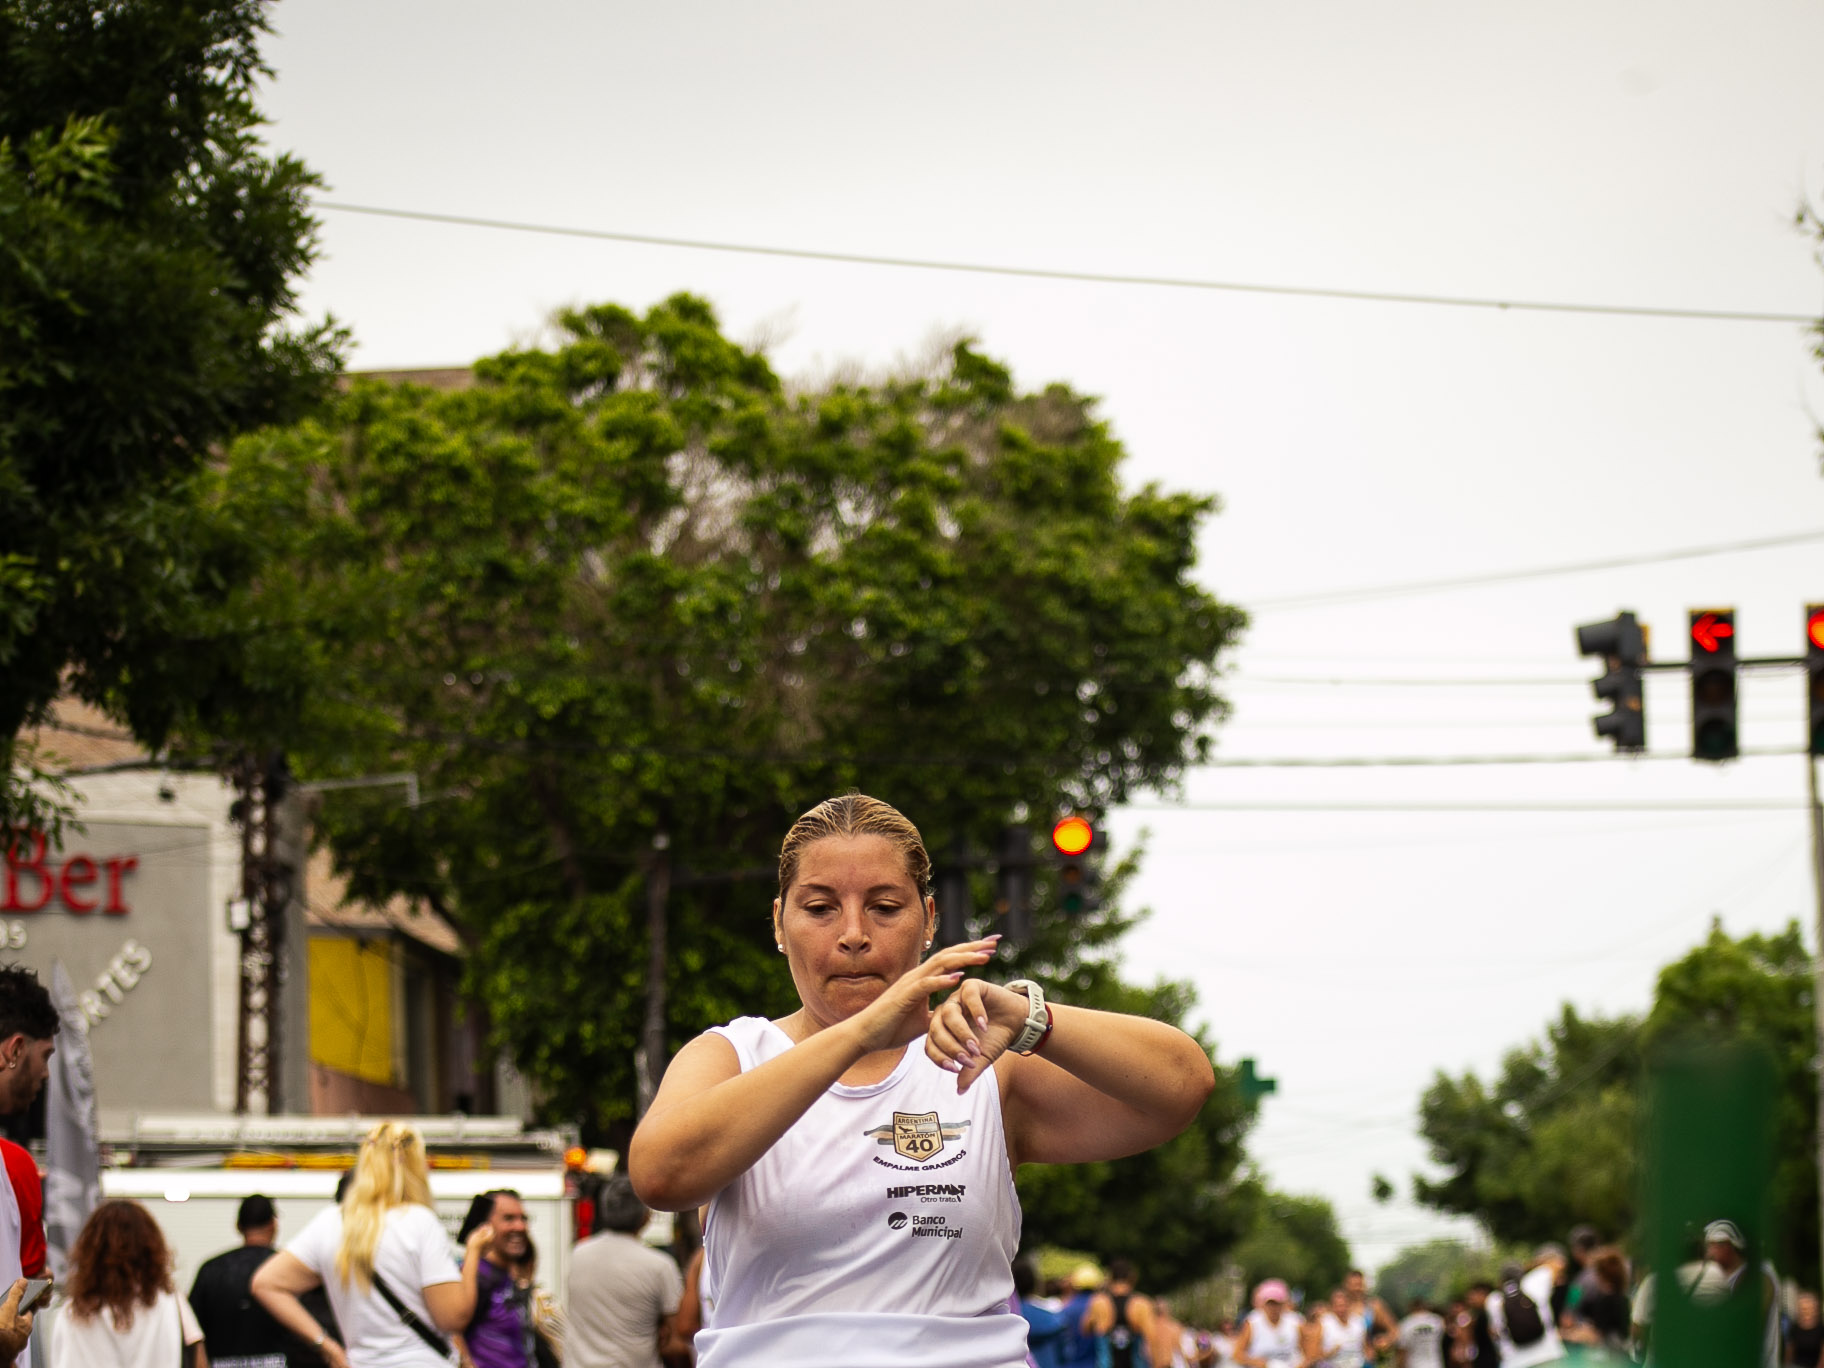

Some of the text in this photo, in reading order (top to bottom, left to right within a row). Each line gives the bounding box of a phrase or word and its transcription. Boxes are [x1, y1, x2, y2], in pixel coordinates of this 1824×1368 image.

[897, 1116, 933, 1124] ARGENTINA
[905, 1138, 934, 1153] 40
[872, 1149, 967, 1171] EMPALME GRANEROS
[912, 1215, 946, 1225] Banco
[911, 1226, 963, 1240] Municipal
